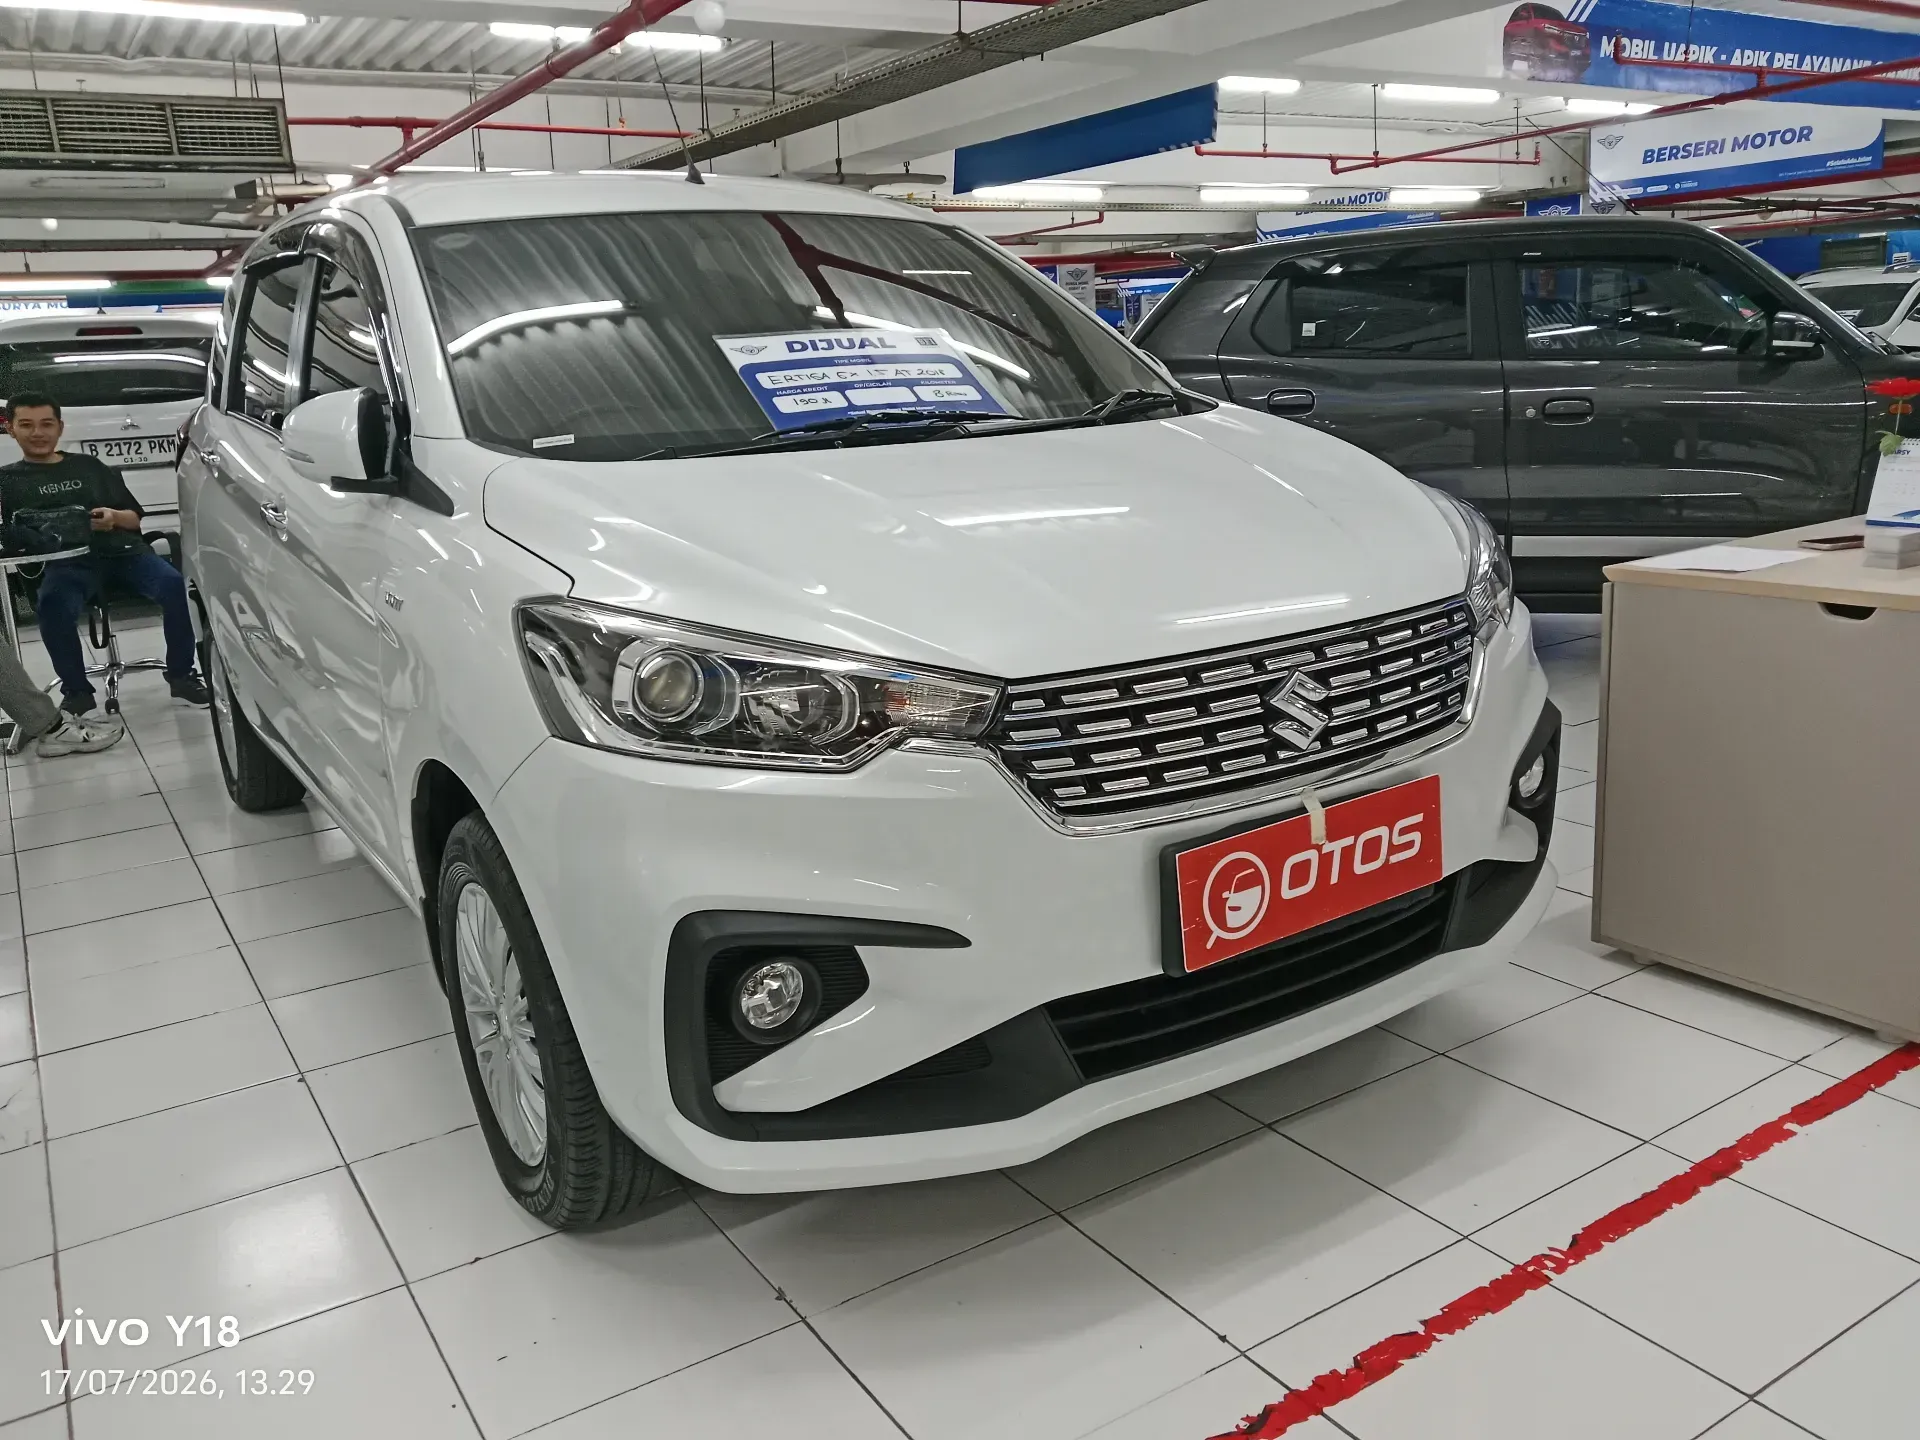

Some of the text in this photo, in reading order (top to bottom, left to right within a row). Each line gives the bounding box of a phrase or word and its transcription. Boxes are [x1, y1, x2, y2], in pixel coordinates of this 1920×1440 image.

[1600, 35, 1658, 60] MOBIL
[1663, 41, 1718, 64] UAPIK
[1730, 48, 1771, 67] APIK
[1641, 125, 1813, 165] BERSERI MOTOR
[0, 302, 42, 310] URYA
[785, 337, 897, 353] DIJUAL
[894, 368, 912, 377] AT
[776, 385, 828, 396] HARGA KREDIT
[88, 439, 176, 458] B 2172 PKM
[39, 480, 82, 495] KENZO
[1280, 812, 1424, 900] OTOS
